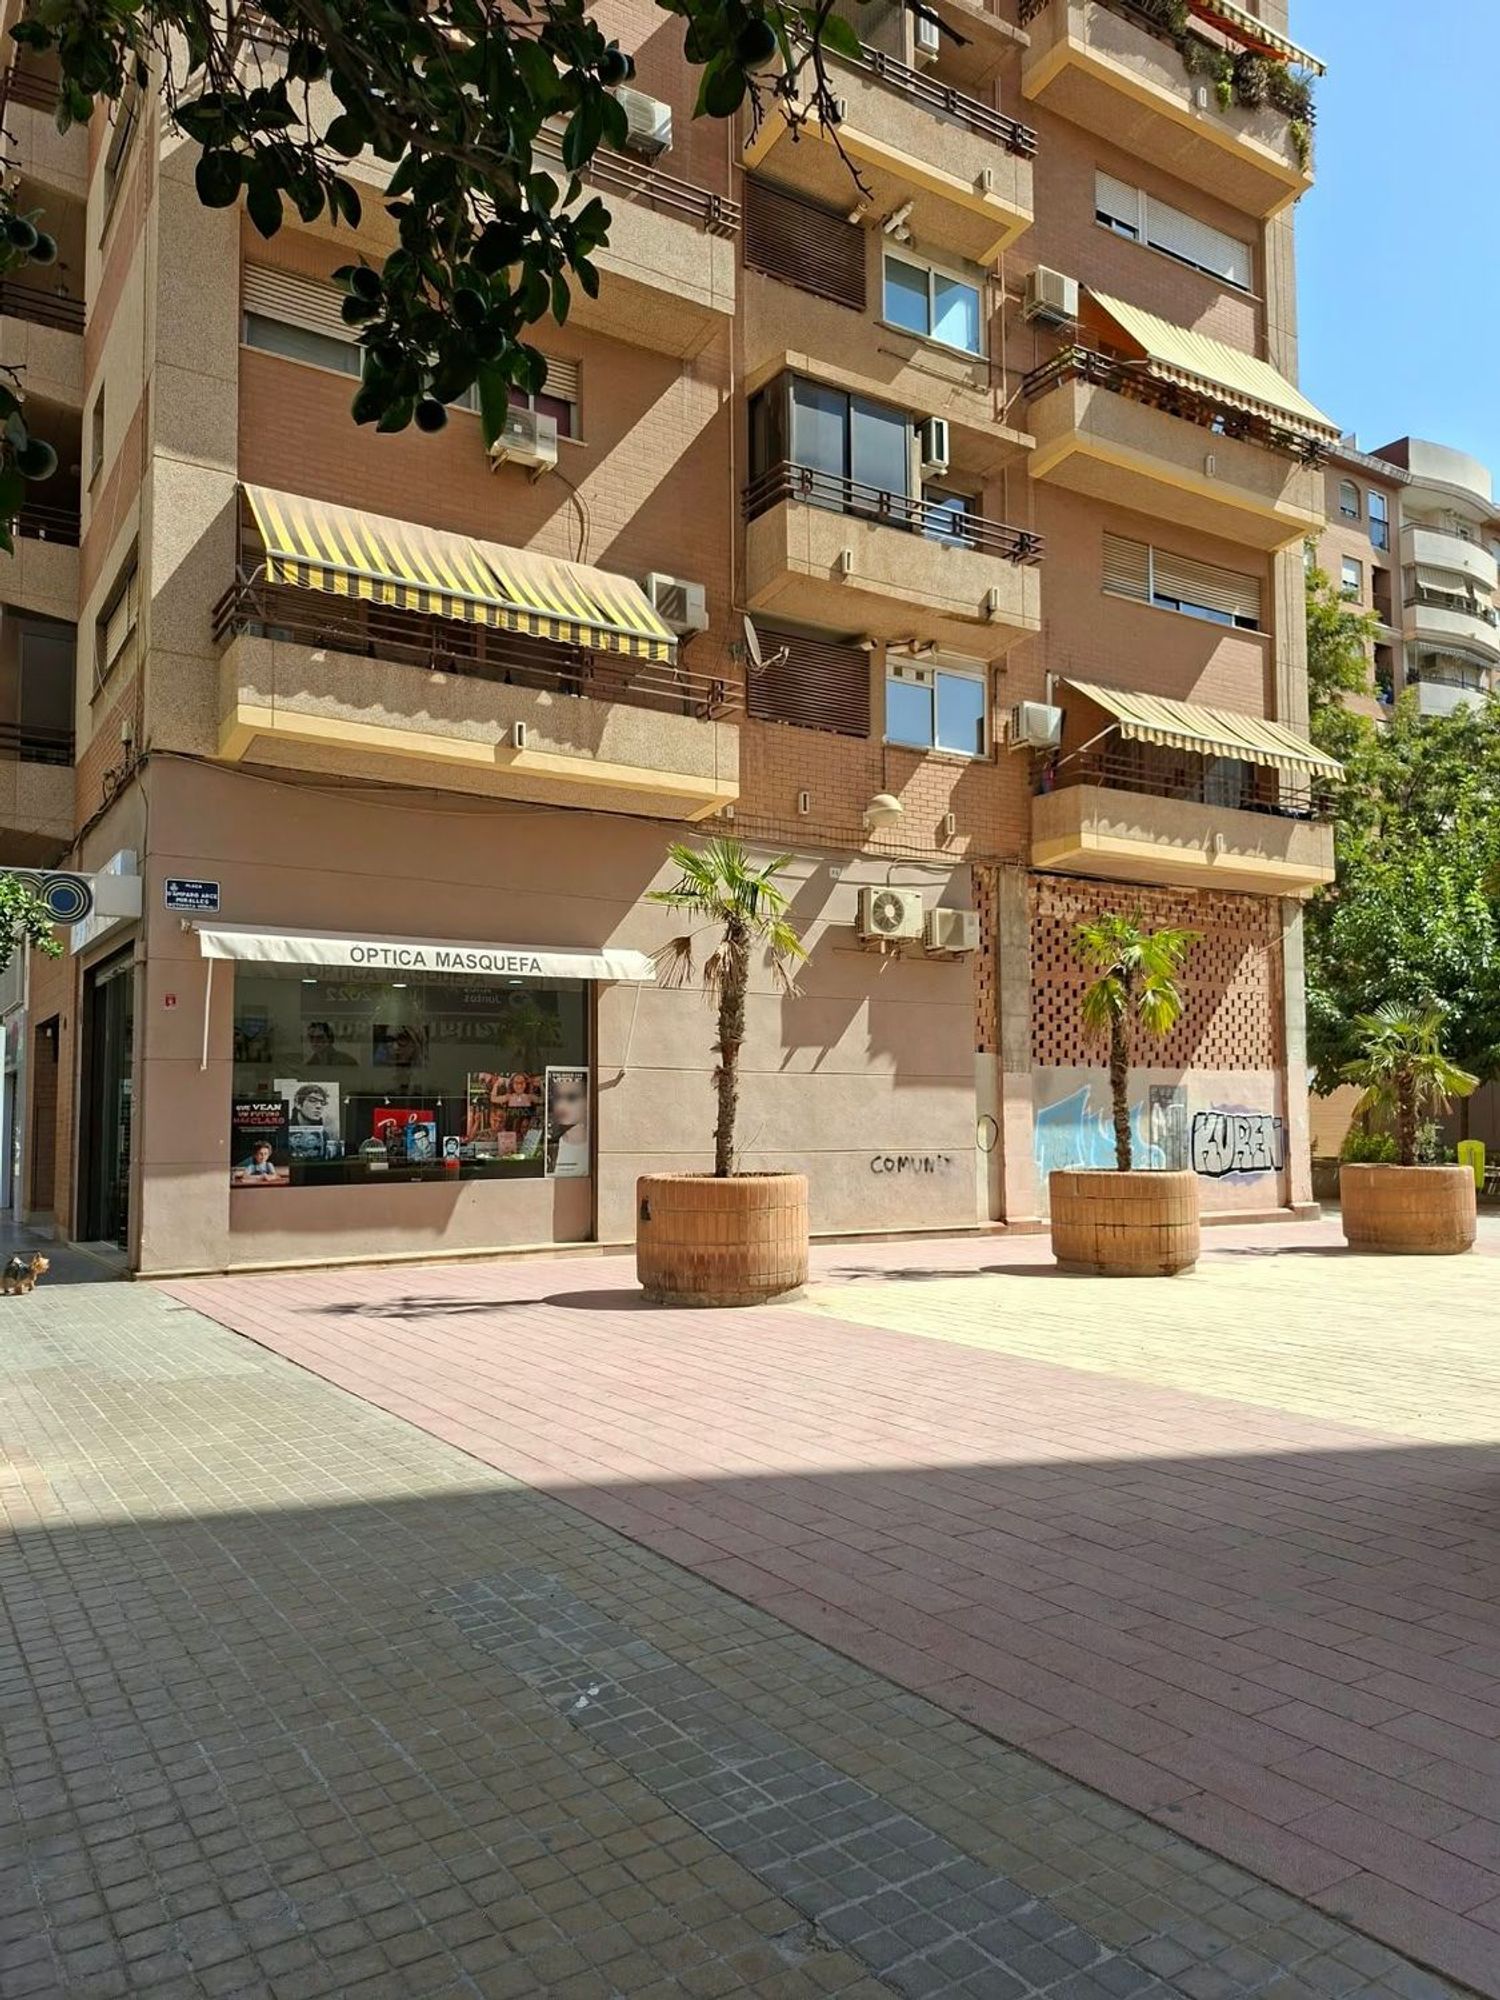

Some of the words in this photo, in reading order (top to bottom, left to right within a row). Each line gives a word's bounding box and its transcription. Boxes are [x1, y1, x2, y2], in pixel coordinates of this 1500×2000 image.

[350, 946, 427, 967] ÓPTICA
[435, 952, 542, 973] MASQUEFA
[253, 1103, 282, 1111] VEAN
